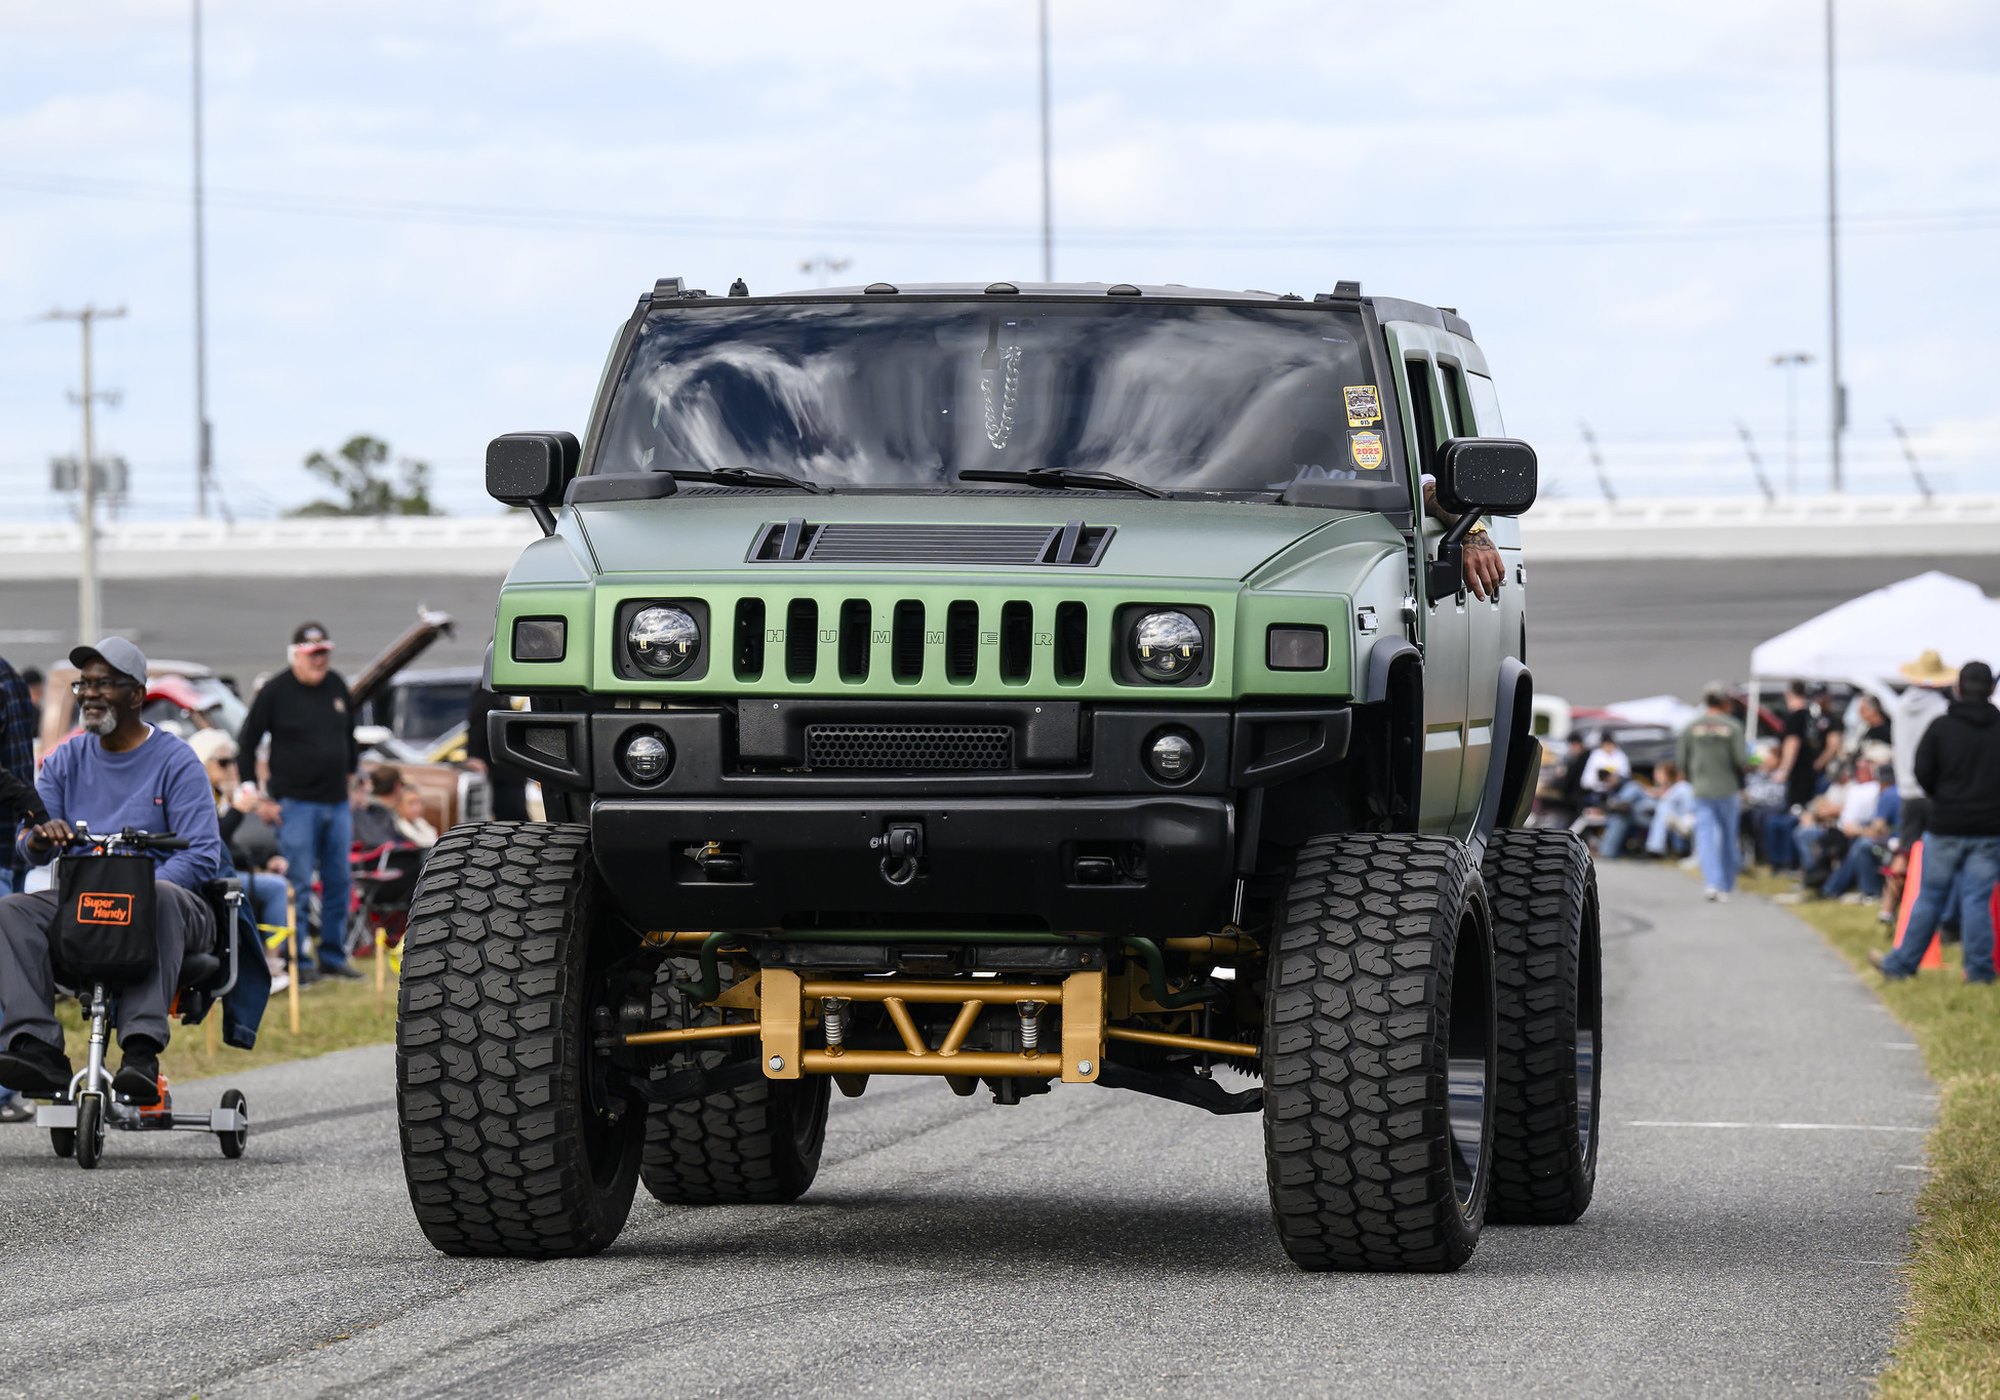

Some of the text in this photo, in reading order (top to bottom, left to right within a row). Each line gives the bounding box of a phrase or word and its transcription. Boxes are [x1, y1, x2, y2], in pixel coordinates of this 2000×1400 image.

[1356, 447, 1380, 455] 2025
[766, 629, 1053, 645] HUMMER
[83, 896, 115, 908] Super
[93, 907, 127, 921] Handy
